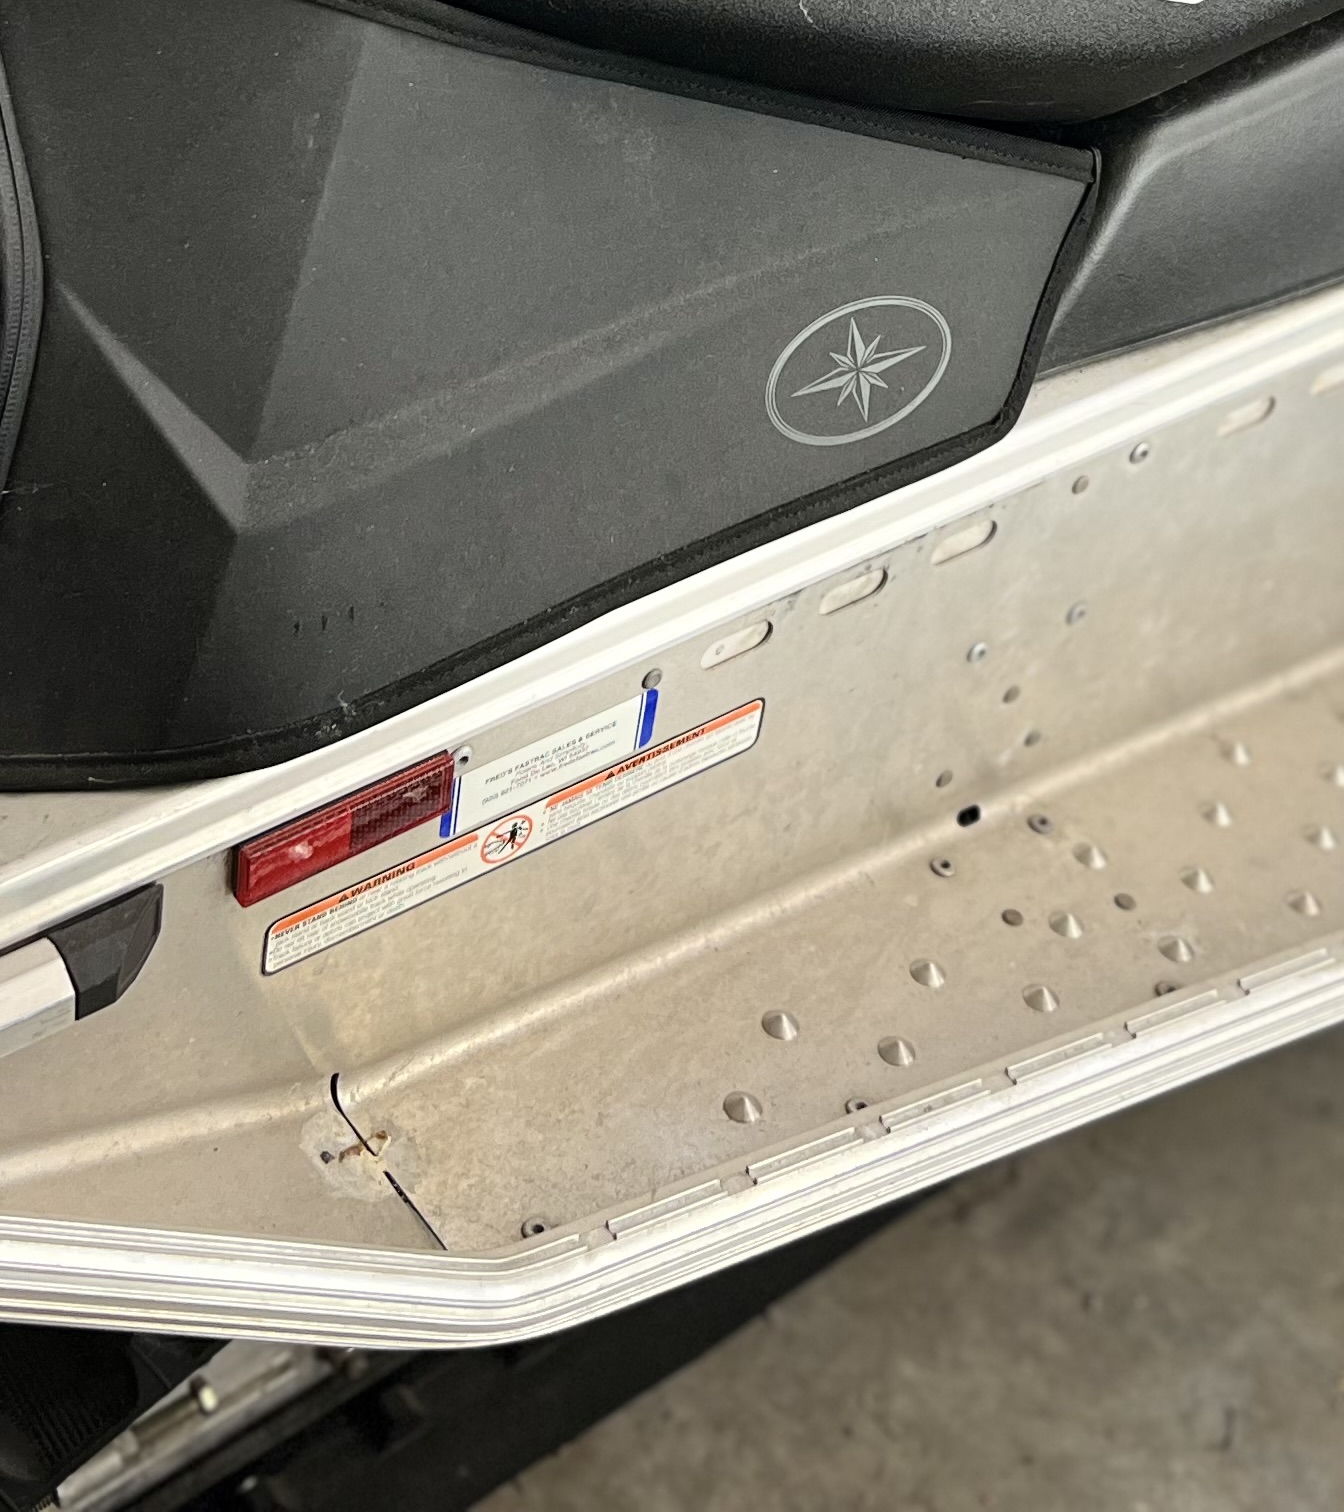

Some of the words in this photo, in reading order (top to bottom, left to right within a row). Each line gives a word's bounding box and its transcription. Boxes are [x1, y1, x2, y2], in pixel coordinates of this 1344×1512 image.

[485, 767, 512, 784] FRED'S
[514, 750, 549, 771] FASTRAC
[551, 738, 576, 754] SALES
[585, 720, 616, 739] SERVICE
[616, 728, 707, 773] AVERTISSEMENT
[348, 863, 416, 896] WARNING
[274, 923, 299, 939] NEVER
[302, 911, 326, 926] STAND
